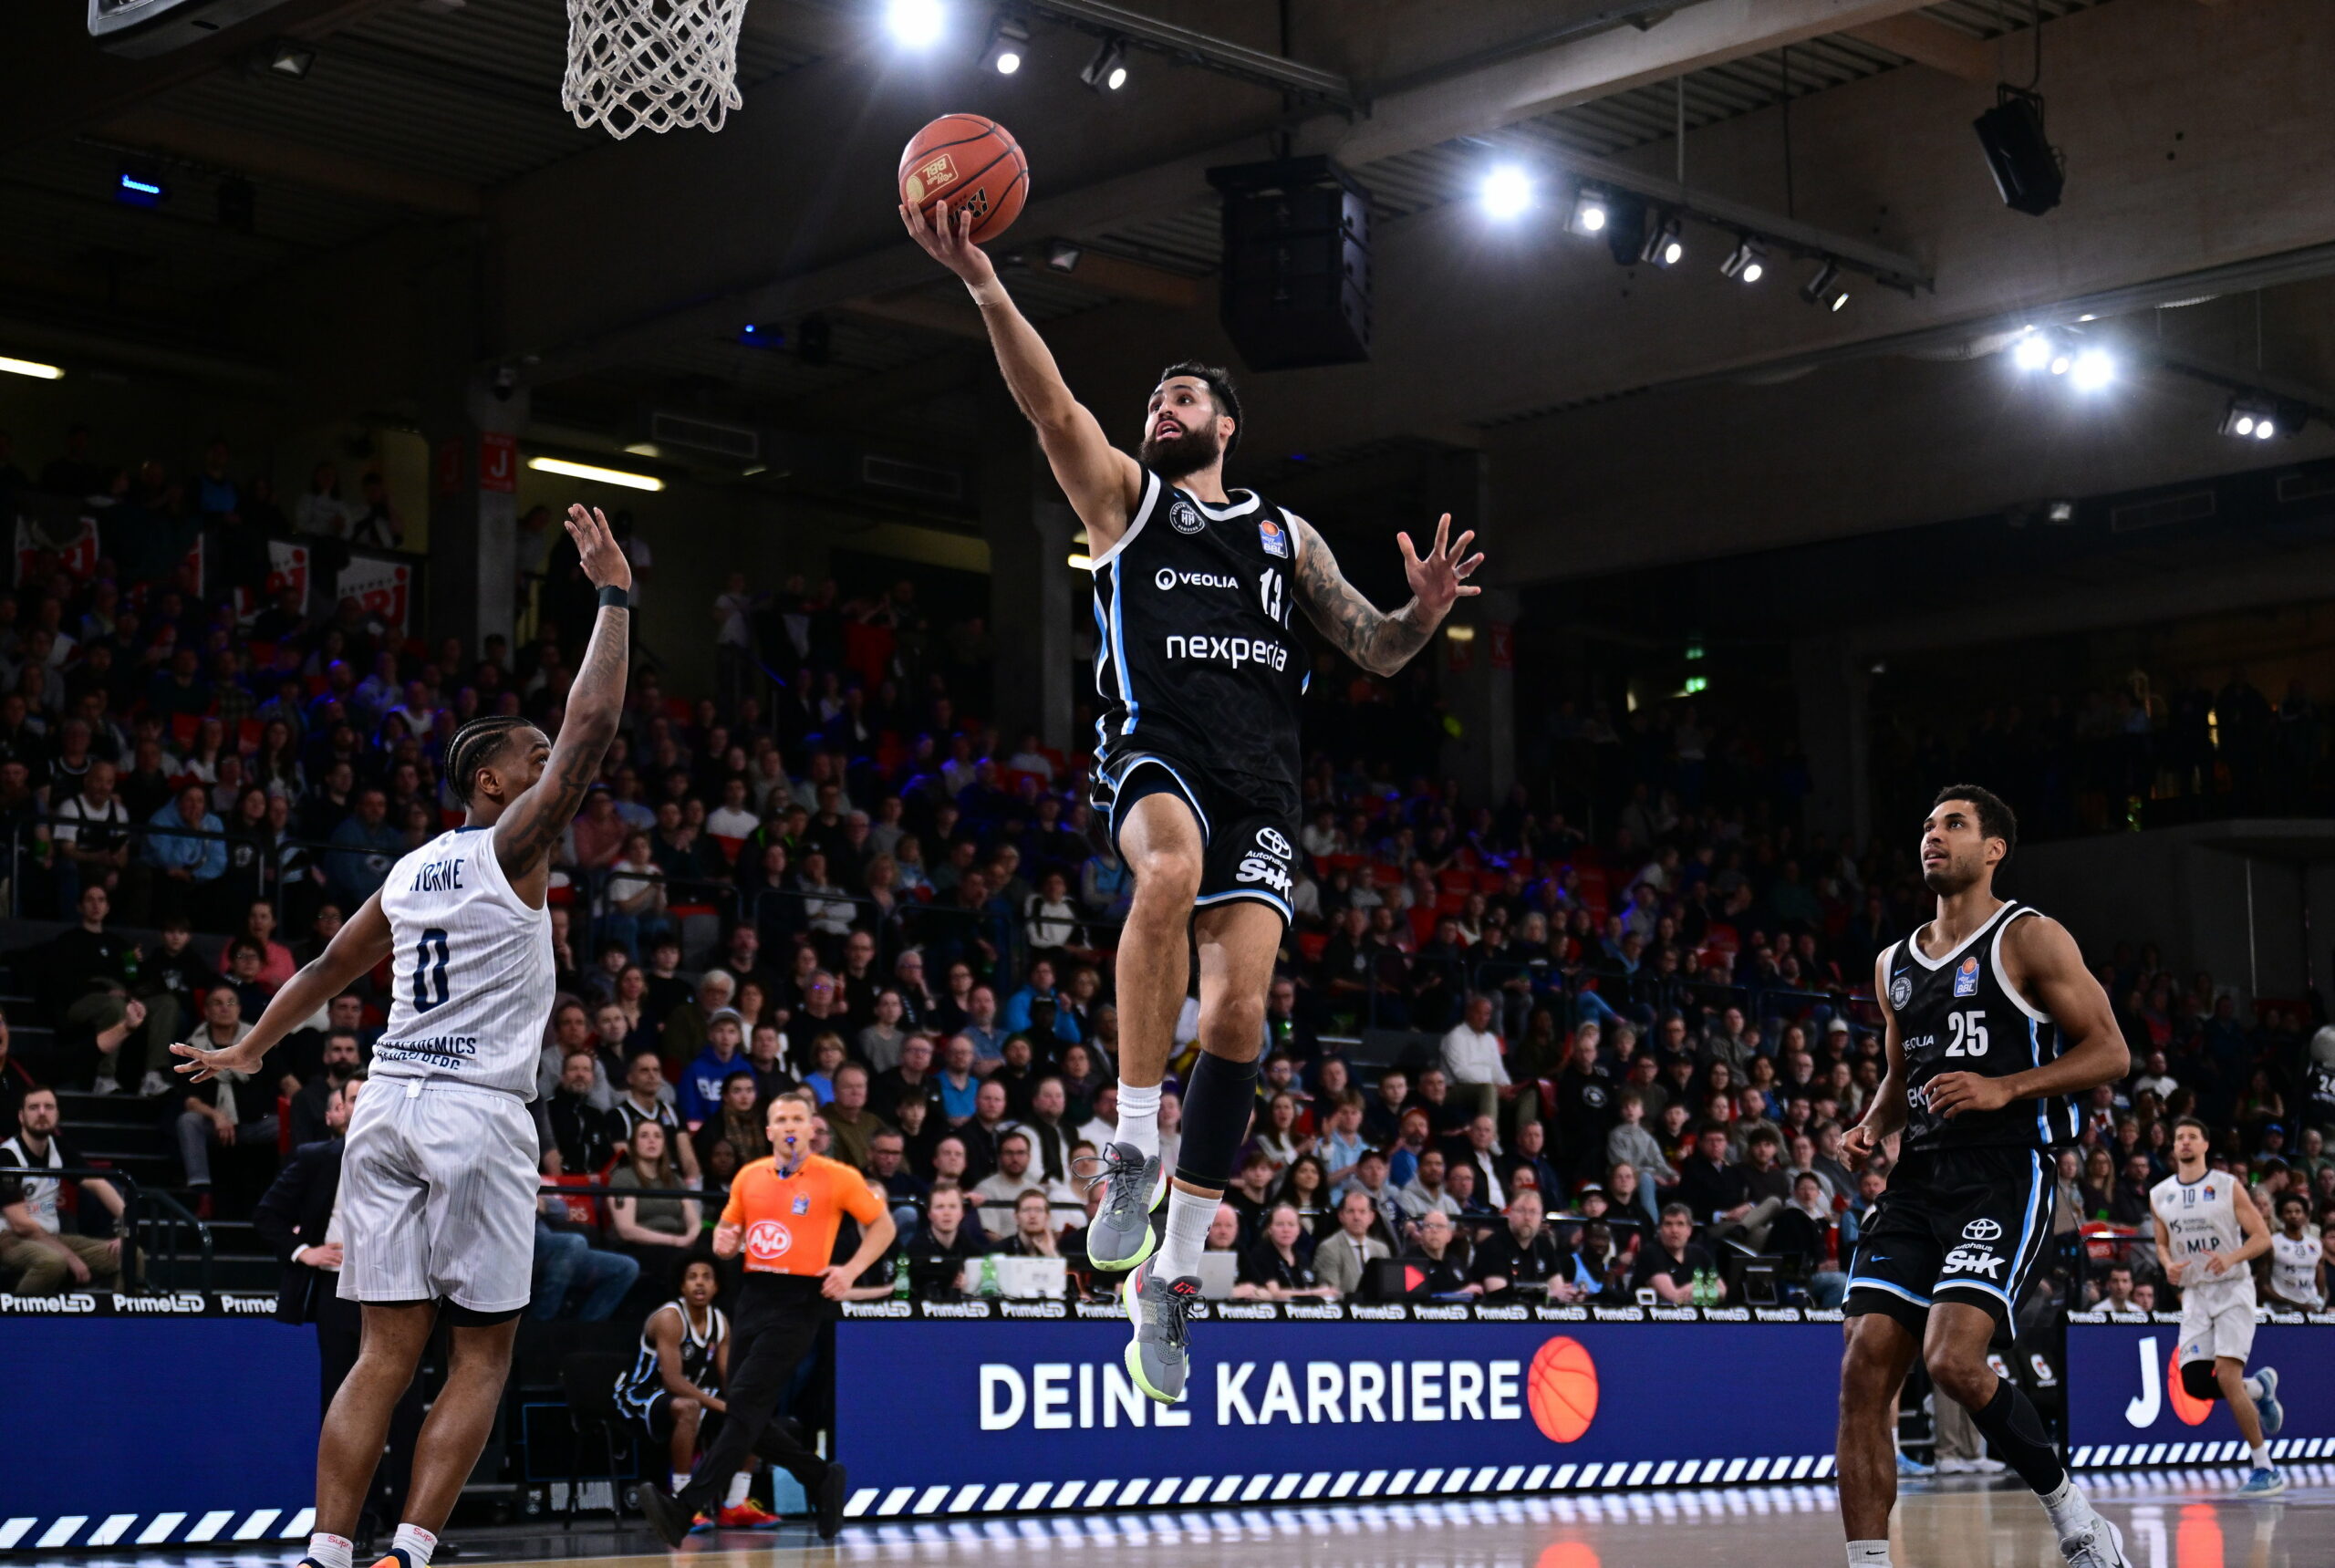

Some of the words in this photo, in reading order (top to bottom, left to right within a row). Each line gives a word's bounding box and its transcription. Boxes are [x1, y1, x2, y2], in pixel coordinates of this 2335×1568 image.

[491, 450, 508, 478] J
[1263, 543, 1284, 556] BBL
[1178, 572, 1239, 589] VEOLIA
[1260, 567, 1282, 622] 13
[1166, 635, 1288, 672] nexperia
[1245, 850, 1288, 872] Autohaus
[412, 928, 450, 1014] 0
[1956, 983, 1975, 993] BBL
[1945, 1010, 1988, 1057] 25
[2182, 1189, 2195, 1204] 10
[0, 1293, 96, 1313] PrimeLED
[112, 1293, 205, 1313] PrimeLED
[221, 1294, 279, 1314] Prime
[1217, 1360, 1522, 1426] KARRIERE
[327, 1535, 353, 1552] Supr
[413, 1527, 436, 1547] Supr
